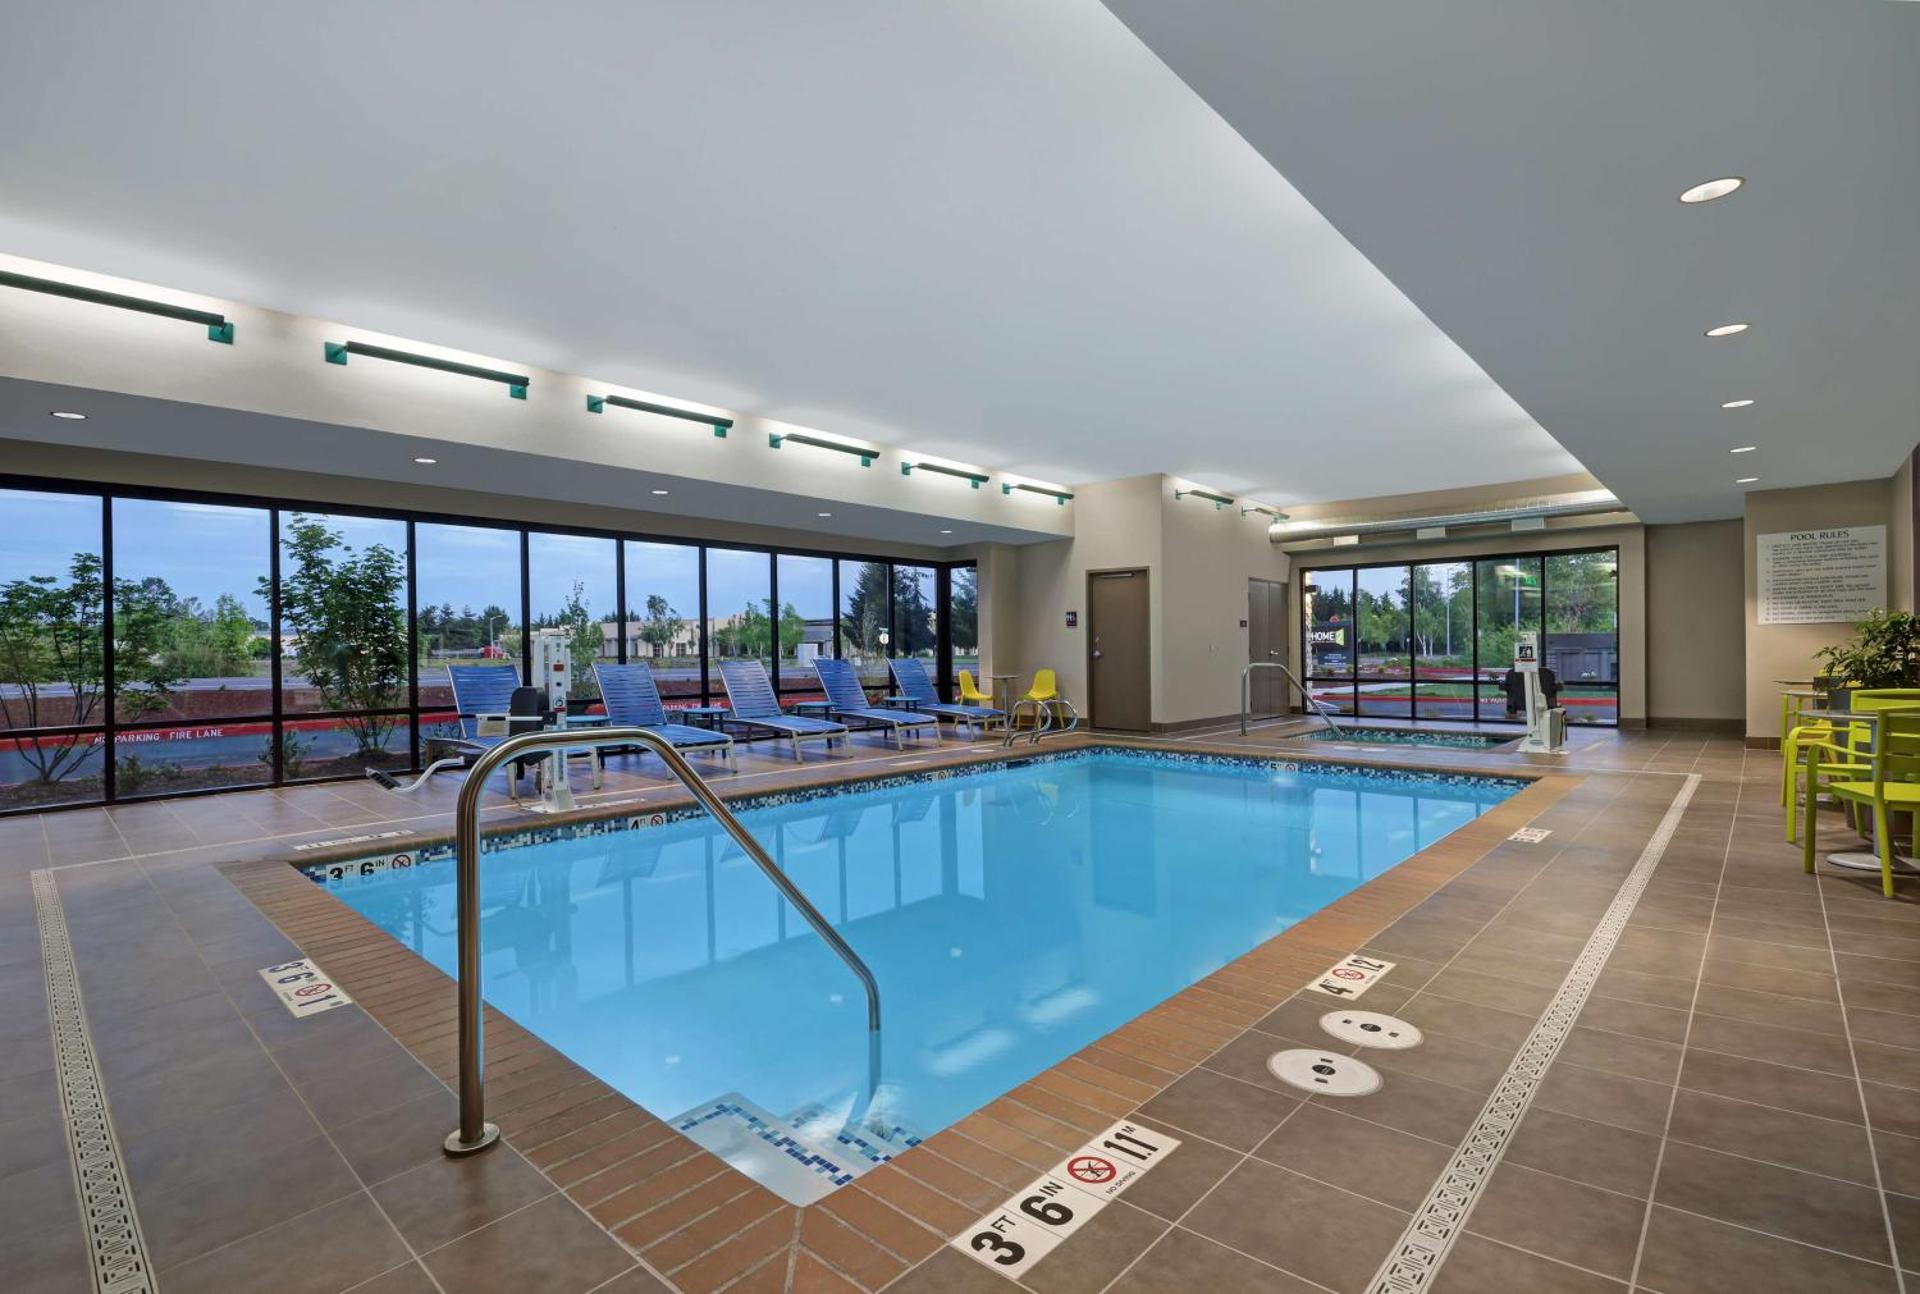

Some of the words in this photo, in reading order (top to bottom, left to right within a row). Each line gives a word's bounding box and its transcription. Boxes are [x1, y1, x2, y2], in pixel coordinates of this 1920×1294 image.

[1790, 533, 1816, 541] POOL
[1820, 530, 1849, 539] RULES
[114, 732, 160, 743] PARKING
[169, 730, 193, 740] FIRE
[196, 728, 224, 738] LANE
[1318, 983, 1354, 995] 4
[1038, 1180, 1065, 1197] IN
[1019, 1195, 1074, 1226] 6
[990, 1214, 1017, 1233] FT
[970, 1231, 1026, 1266] 3
